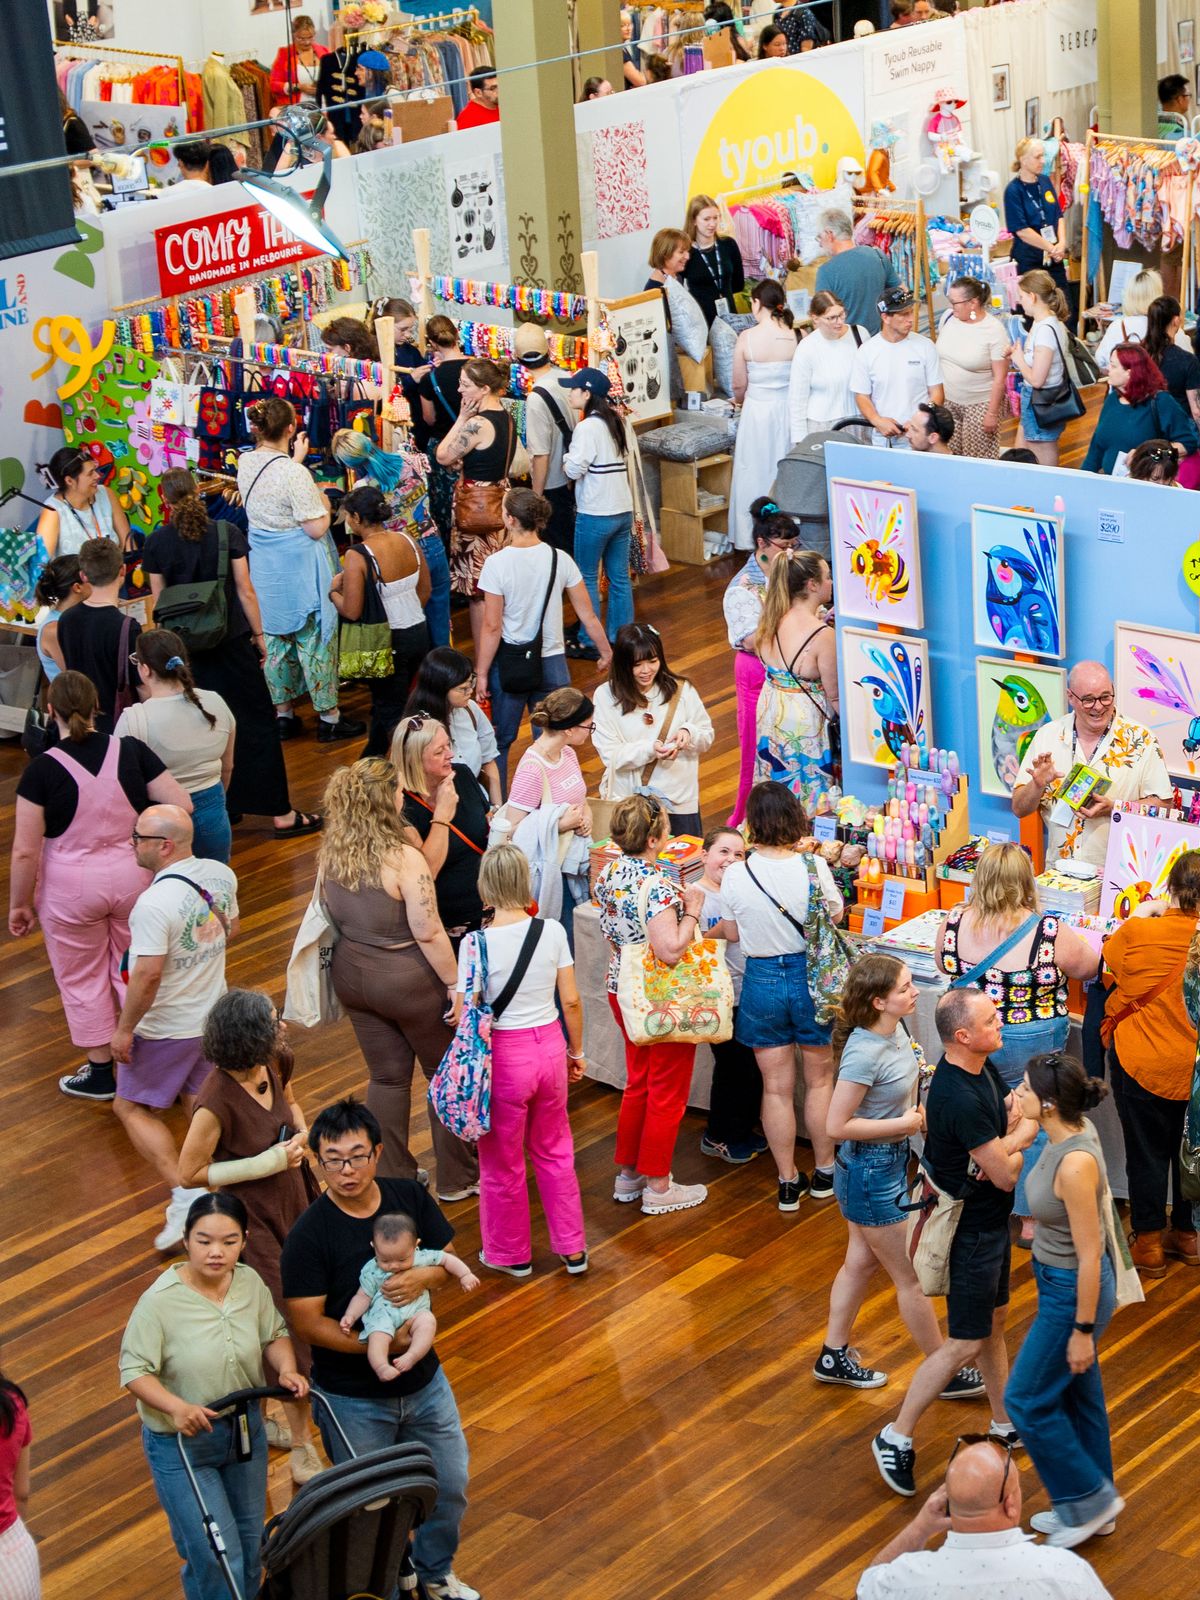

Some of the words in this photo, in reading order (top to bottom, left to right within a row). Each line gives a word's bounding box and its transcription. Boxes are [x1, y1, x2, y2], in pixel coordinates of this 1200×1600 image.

[884, 50, 906, 68] Tyoub
[908, 40, 942, 57] Reusable
[889, 67, 910, 81] Swim
[911, 60, 936, 73] Nappy
[188, 262, 238, 286] HANDMADE
[239, 260, 250, 272] IN
[252, 245, 304, 268] MELBOURNE
[1100, 522, 1121, 534] $290
